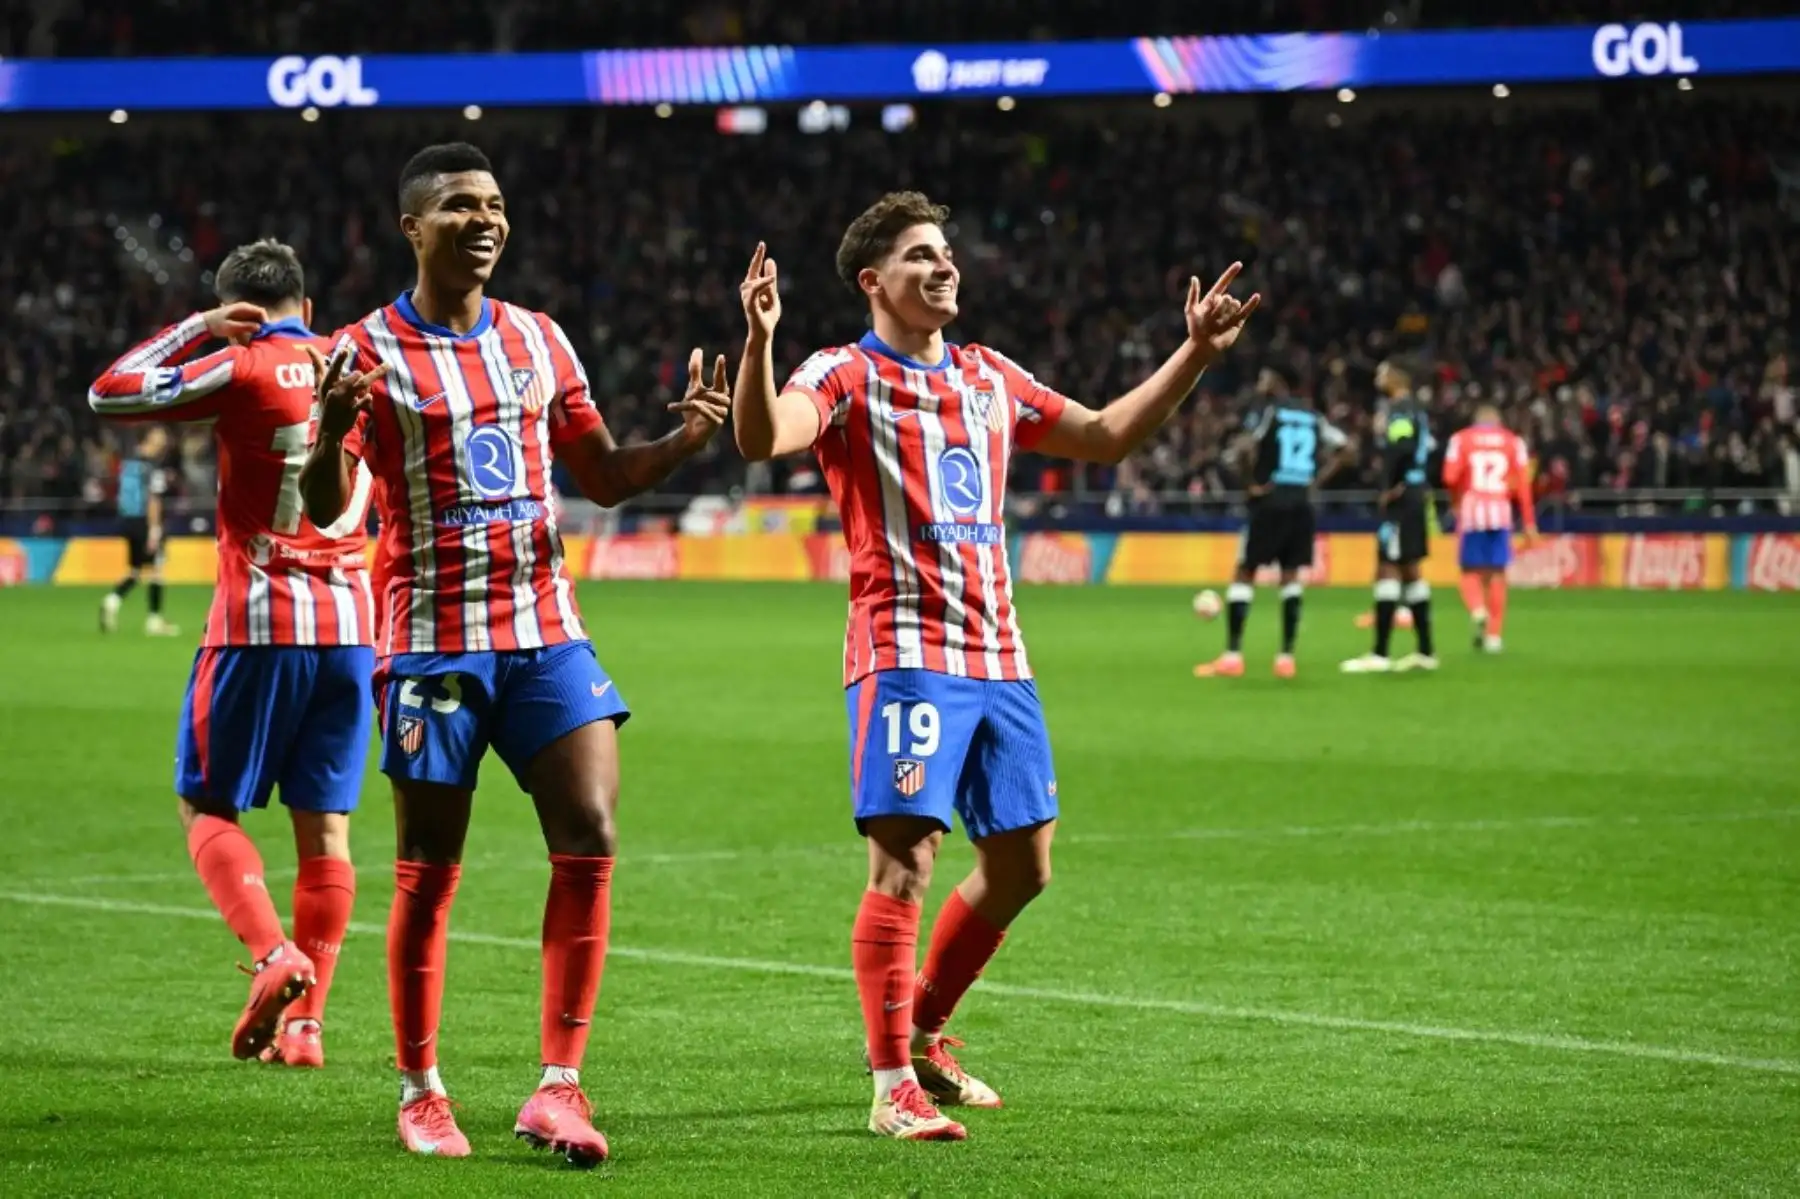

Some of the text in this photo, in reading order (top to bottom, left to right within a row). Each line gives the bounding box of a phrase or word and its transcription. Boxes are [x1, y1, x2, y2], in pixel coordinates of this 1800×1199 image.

[1592, 22, 1699, 76] GOL
[267, 55, 378, 107] GOL
[1276, 425, 1316, 470] 12
[1470, 451, 1509, 493] 12
[445, 505, 513, 525] RIYADH
[921, 525, 977, 541] RIYADH
[882, 702, 941, 757] 19
